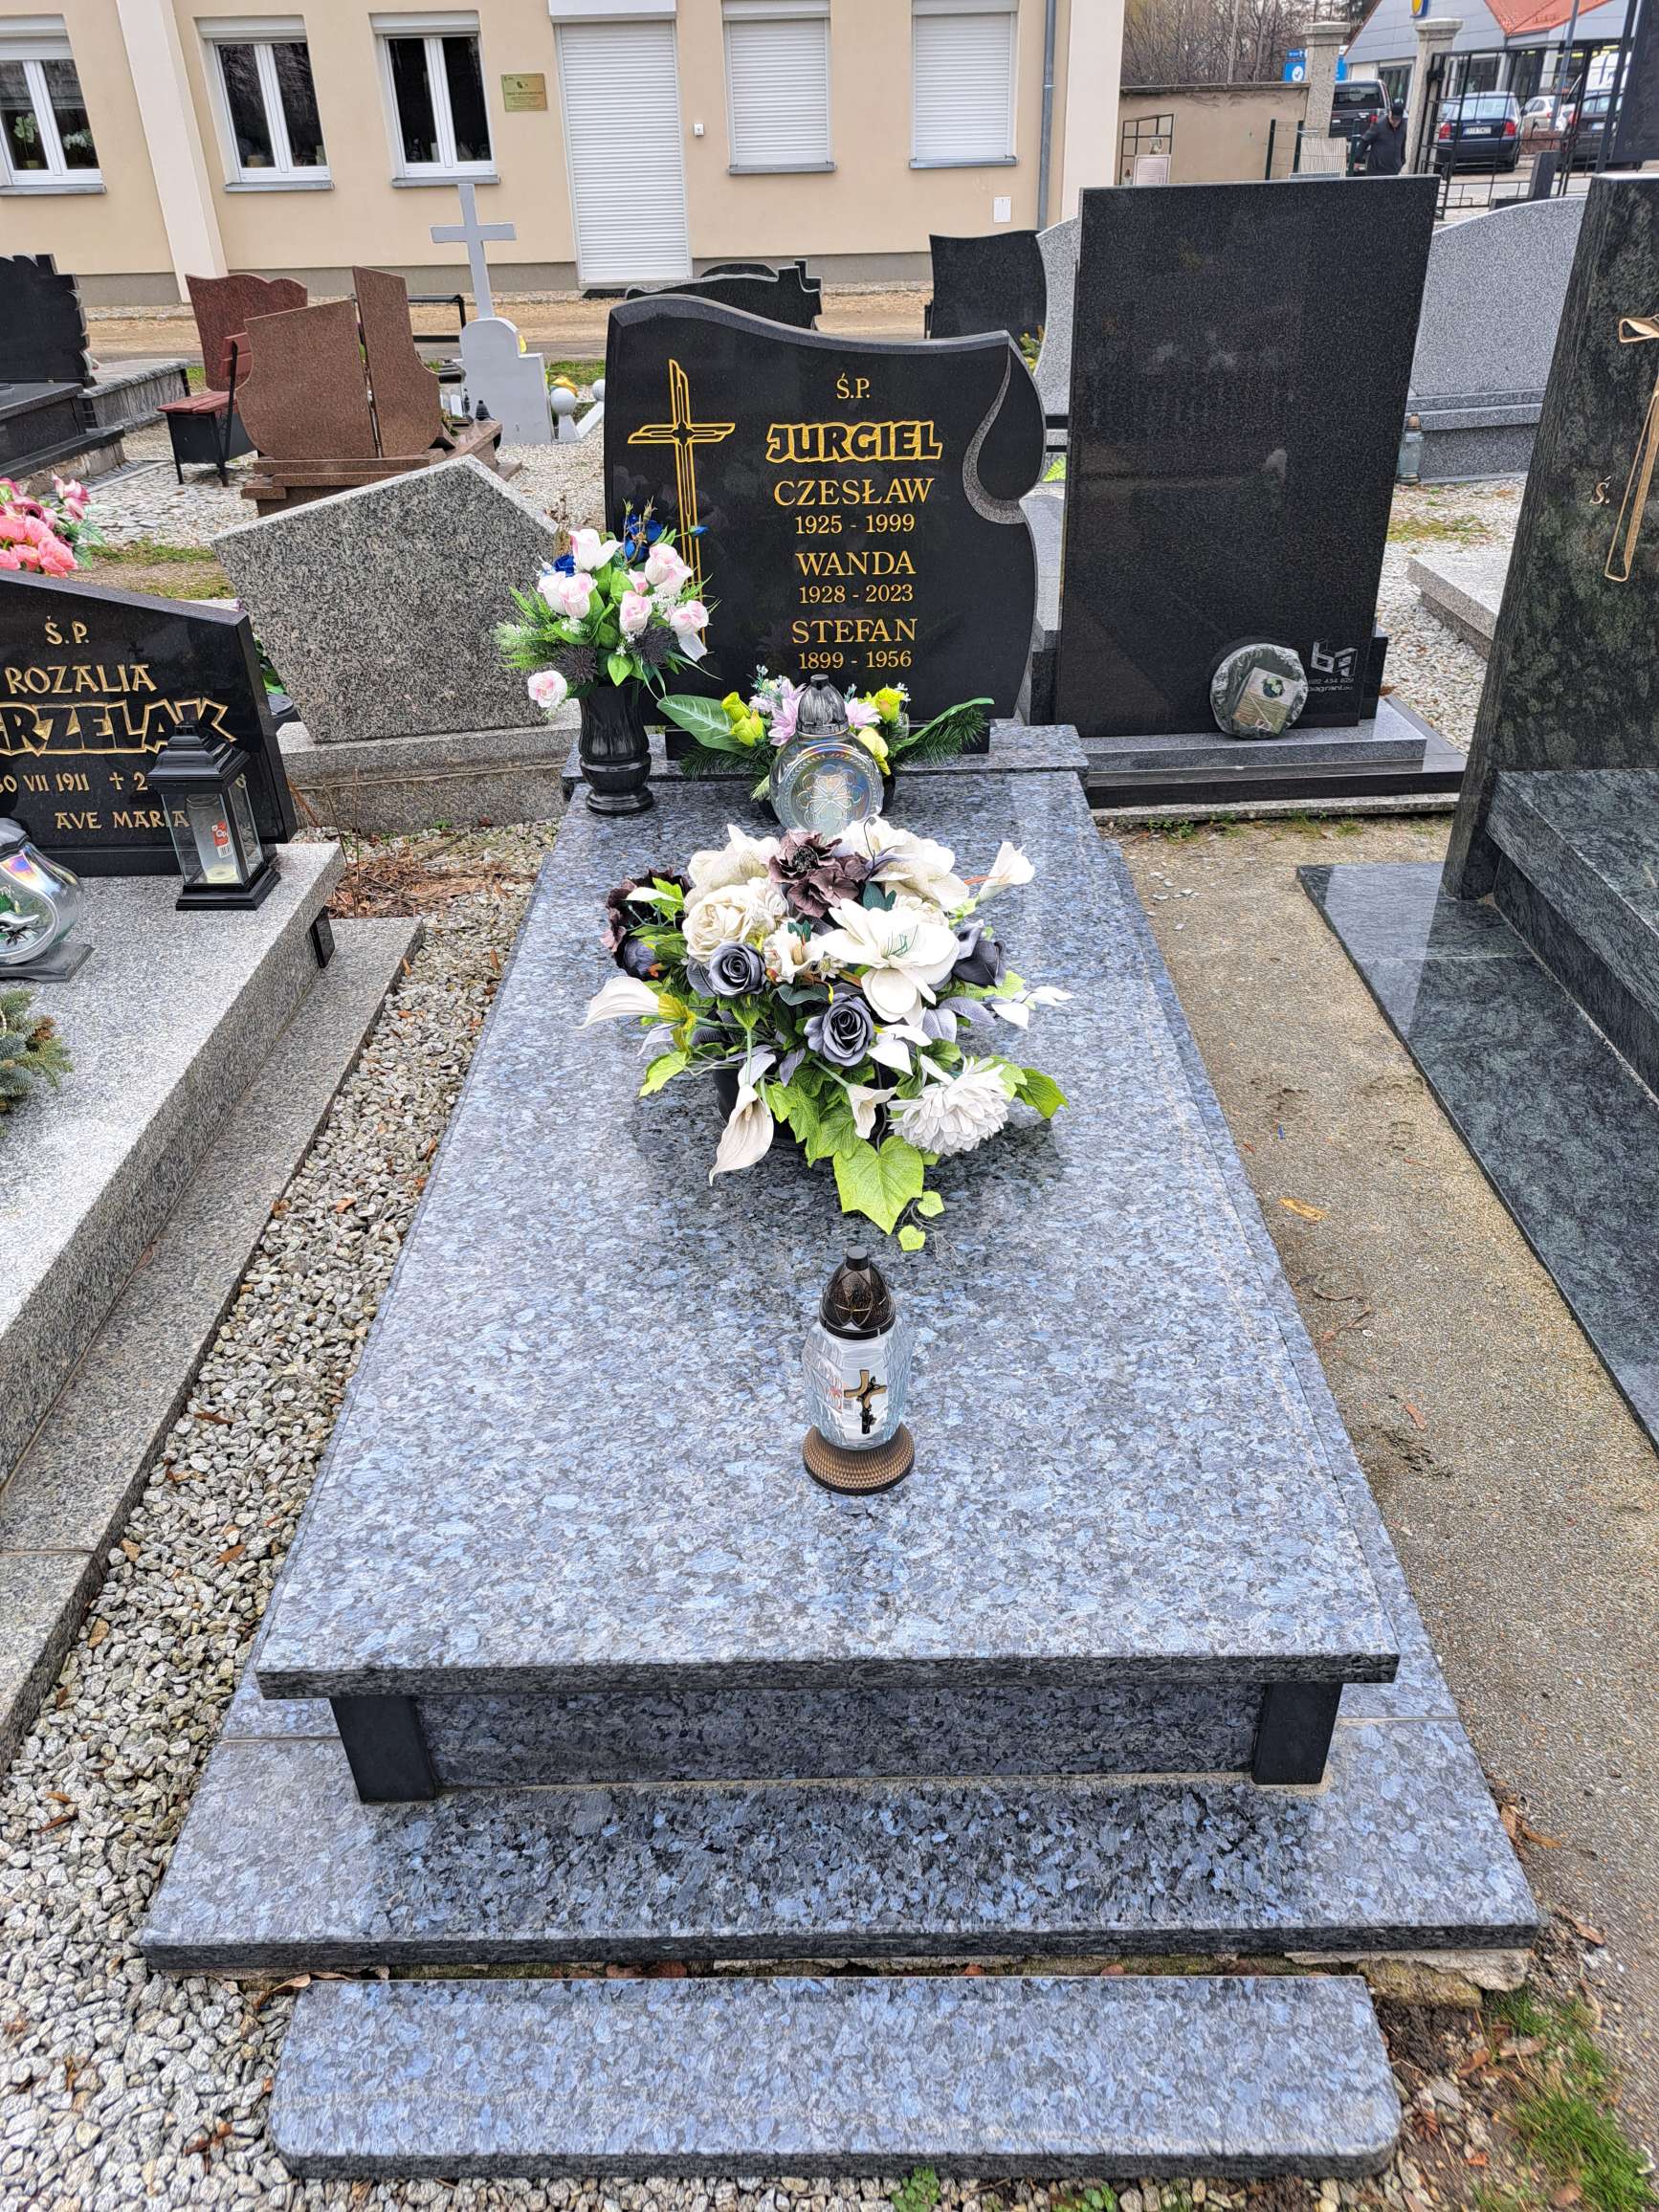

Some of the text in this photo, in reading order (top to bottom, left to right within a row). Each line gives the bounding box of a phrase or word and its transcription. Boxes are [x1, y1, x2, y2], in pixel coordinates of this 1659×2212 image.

[836, 372, 871, 399] Ś.P.
[765, 420, 943, 464] JURGIEL
[773, 476, 935, 506] CZESŁAW
[795, 515, 843, 535] 1925
[865, 513, 916, 533] 1999
[795, 550, 917, 576] WANDA
[799, 586, 846, 604] 1928
[865, 584, 914, 603] 2023
[791, 618, 918, 644] STEFAN
[798, 652, 844, 670] 1899
[866, 650, 912, 668] 1956
[5, 664, 158, 695] ROZALIA
[0, 697, 237, 757] RZELAK
[23, 774, 50, 792] VII
[55, 772, 91, 792] 1911
[55, 809, 191, 830] AVE MARIA
